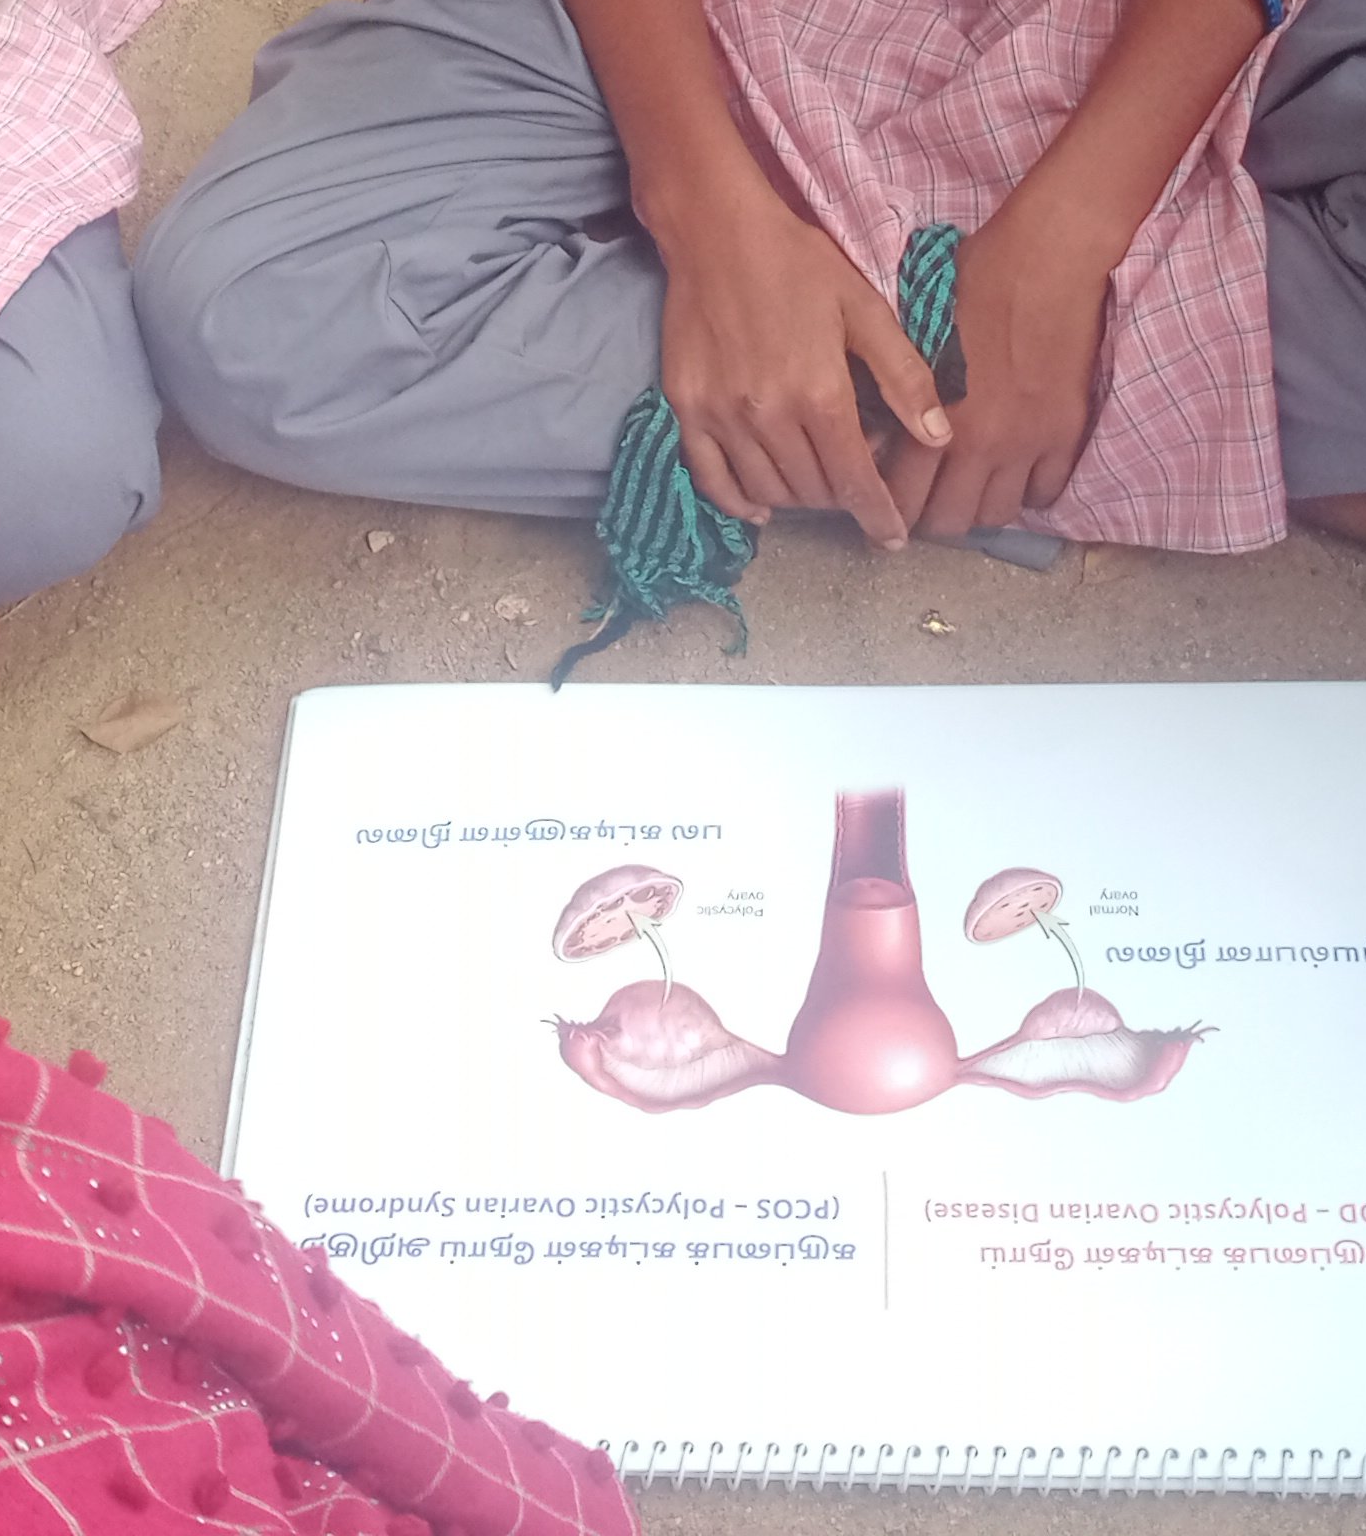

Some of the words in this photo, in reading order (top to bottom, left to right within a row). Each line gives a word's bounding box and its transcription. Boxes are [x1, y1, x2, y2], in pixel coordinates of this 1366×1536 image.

[355, 820, 452, 850] நிலை
[458, 818, 663, 848] கட்டிகளுள்ள
[671, 824, 722, 841] பல
[726, 888, 765, 903] ovary
[1099, 887, 1139, 901] ovary
[696, 903, 764, 918] Polycystic
[1089, 904, 1140, 917] Normal
[1105, 938, 1207, 970] நிலை
[303, 1190, 456, 1219] Syndrome)
[465, 1196, 576, 1219] Ovarian
[584, 1191, 725, 1221] Polycystic
[756, 1195, 840, 1221] (PCOS
[924, 1198, 1039, 1225] Disease)
[1049, 1202, 1159, 1225] Ovarian
[1167, 1196, 1308, 1225] Polycystic
[439, 1232, 535, 1266] நோய்
[543, 1233, 677, 1266] கட்டிகள்
[685, 1234, 857, 1267] கருப்பைக்
[979, 1238, 1075, 1271] நோய்
[1082, 1240, 1213, 1271] கட்டிகள்
